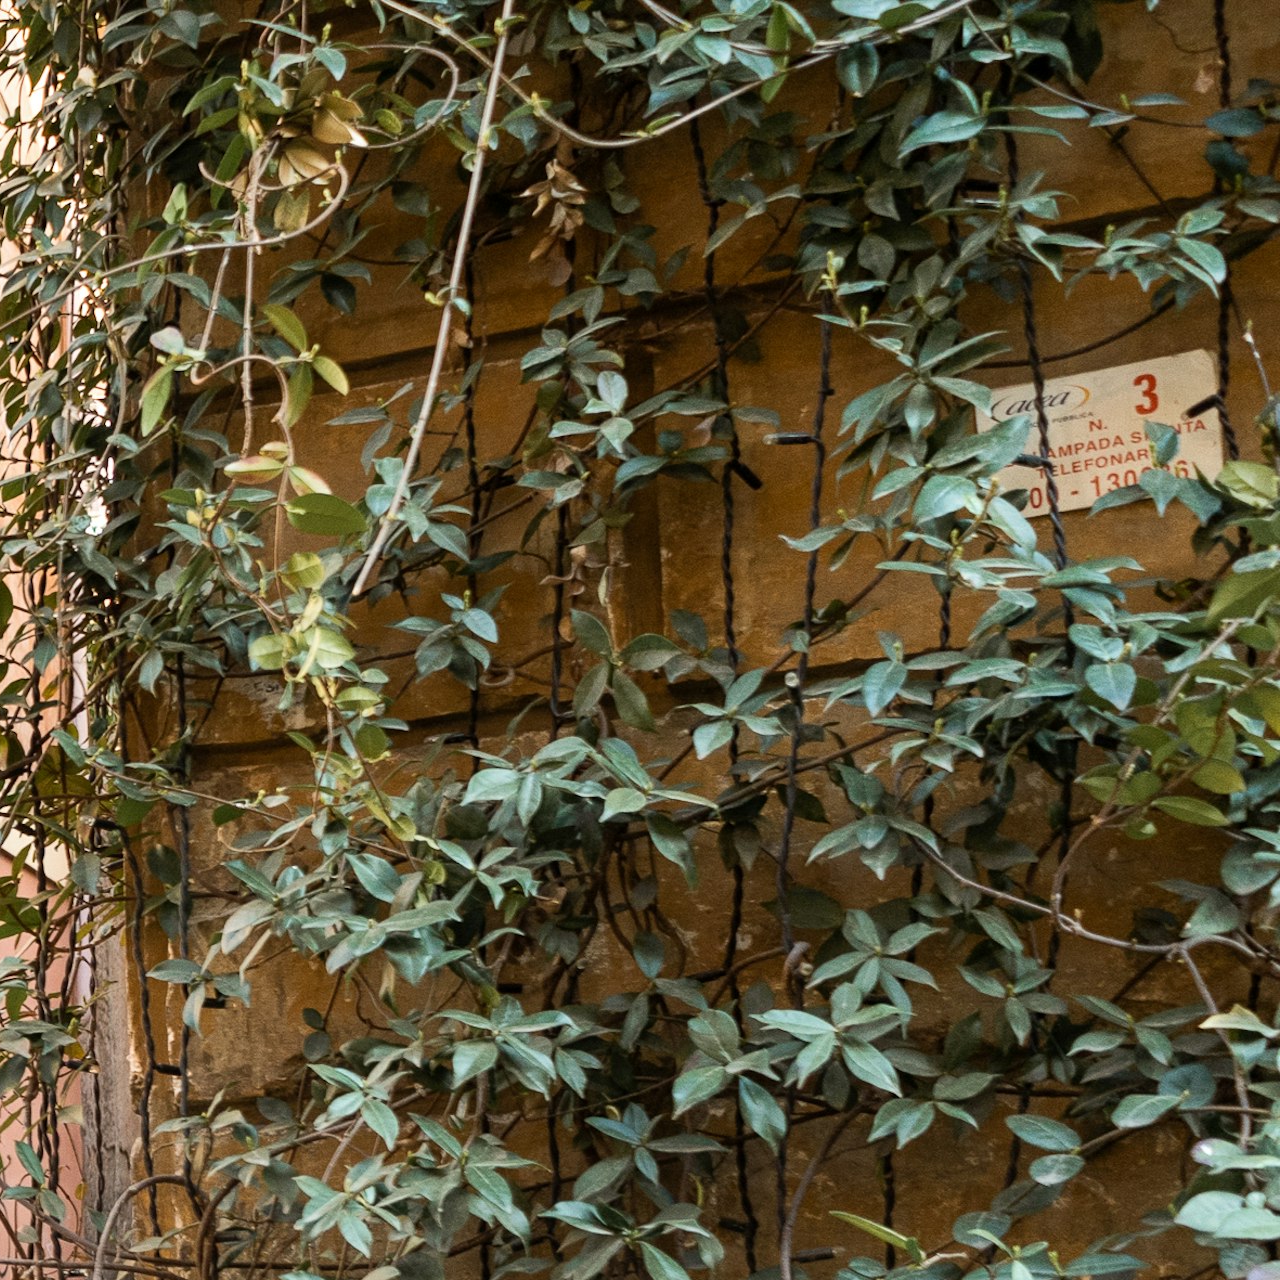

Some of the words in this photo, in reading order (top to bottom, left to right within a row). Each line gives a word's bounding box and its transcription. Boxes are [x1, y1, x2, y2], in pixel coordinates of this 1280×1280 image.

[1132, 373, 1160, 416] 3
[1088, 418, 1108, 432] N.
[1033, 435, 1125, 460] AMPADA
[1036, 448, 1149, 479] TELEFONAR
